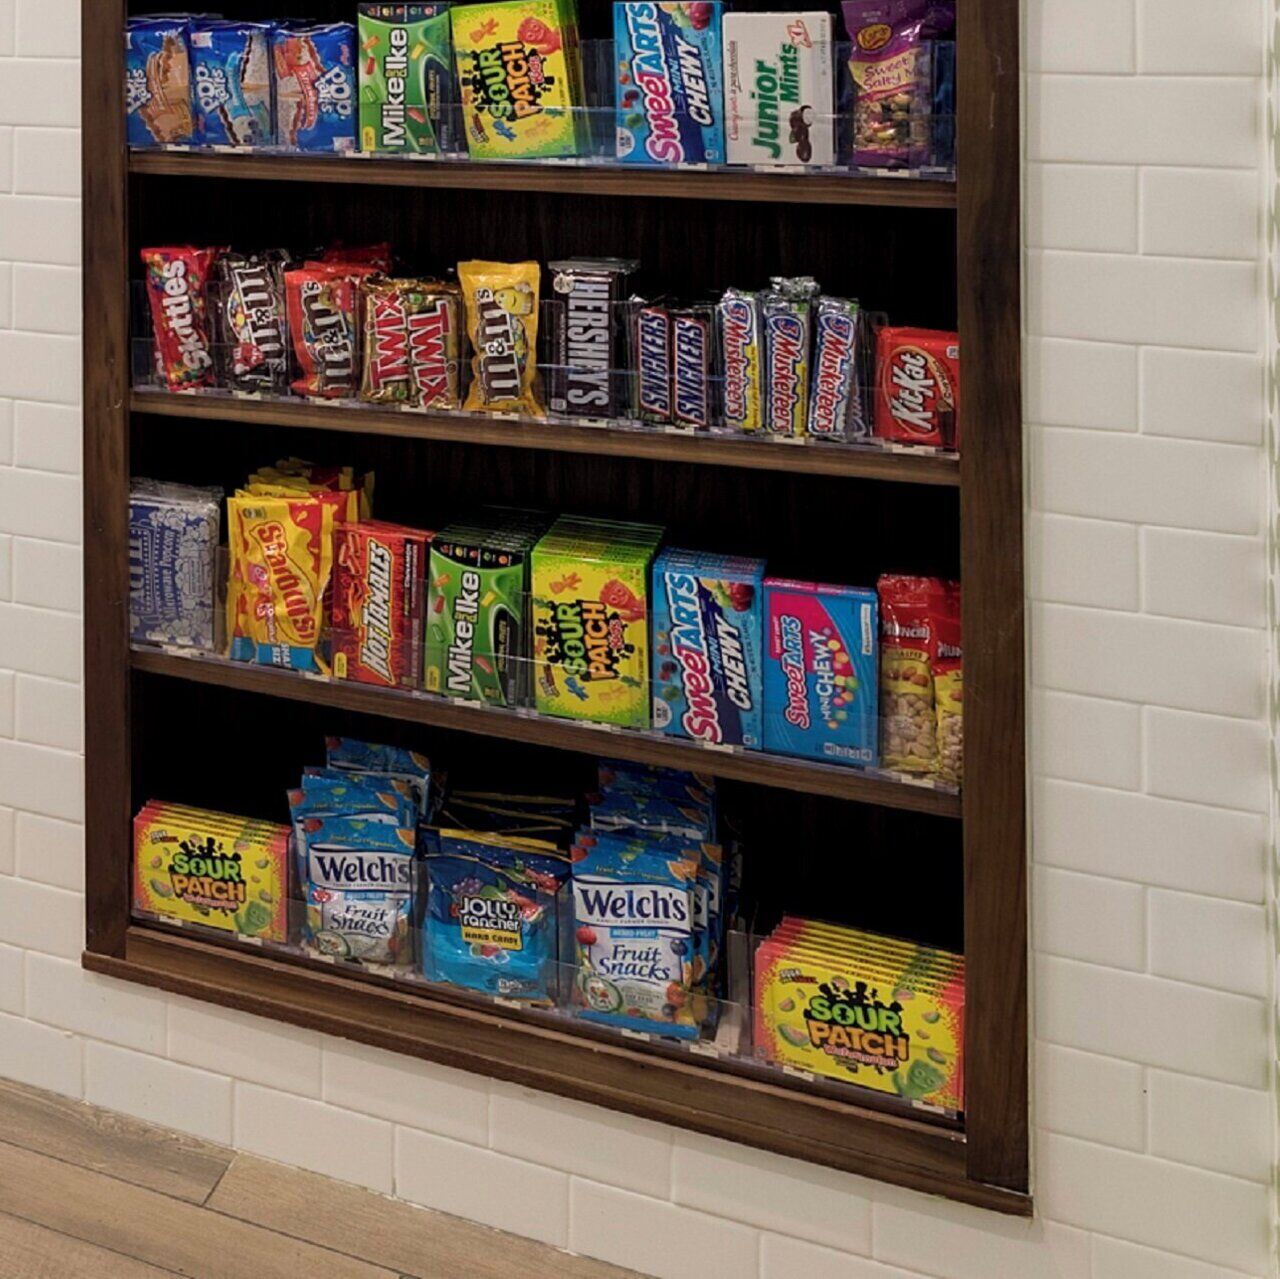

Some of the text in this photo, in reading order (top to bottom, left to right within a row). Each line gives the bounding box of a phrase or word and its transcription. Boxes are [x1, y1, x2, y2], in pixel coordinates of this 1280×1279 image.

[479, 49, 512, 119] SOUR
[503, 42, 543, 118] PATCH
[675, 34, 713, 126] CHEWY
[780, 43, 800, 104] Mints
[383, 77, 406, 146] Mike
[751, 60, 782, 160] Junior
[162, 259, 213, 370] Skittles
[369, 292, 409, 390] TWIX
[567, 280, 610, 407] HERSHEY'S
[408, 300, 450, 408] TWIX
[640, 312, 669, 417] SNICKERS
[675, 321, 705, 425] SNICKERS
[725, 314, 748, 420] Musketeers
[771, 333, 798, 439] Musketeers
[815, 331, 846, 437] Musketeers
[159, 529, 178, 568] Popcorn
[455, 570, 481, 610] Ike
[448, 620, 472, 691] Mike
[557, 605, 586, 674] SOUR
[582, 601, 617, 680] PATCH
[715, 612, 751, 710] CHEWY
[809, 631, 835, 695] CHEWY
[172, 851, 241, 880] SOUR
[172, 874, 246, 902] PATCH
[315, 854, 411, 884] Welch's
[330, 915, 390, 937] Snacks
[344, 904, 389, 921] Fruit
[459, 897, 518, 919] JOLLY
[579, 888, 687, 921] Welch's
[491, 934, 519, 946] CANDY
[598, 957, 671, 981] Snacks
[611, 944, 662, 963] Fruit
[807, 1020, 909, 1062] PATCH
[810, 996, 902, 1036] SOUR
